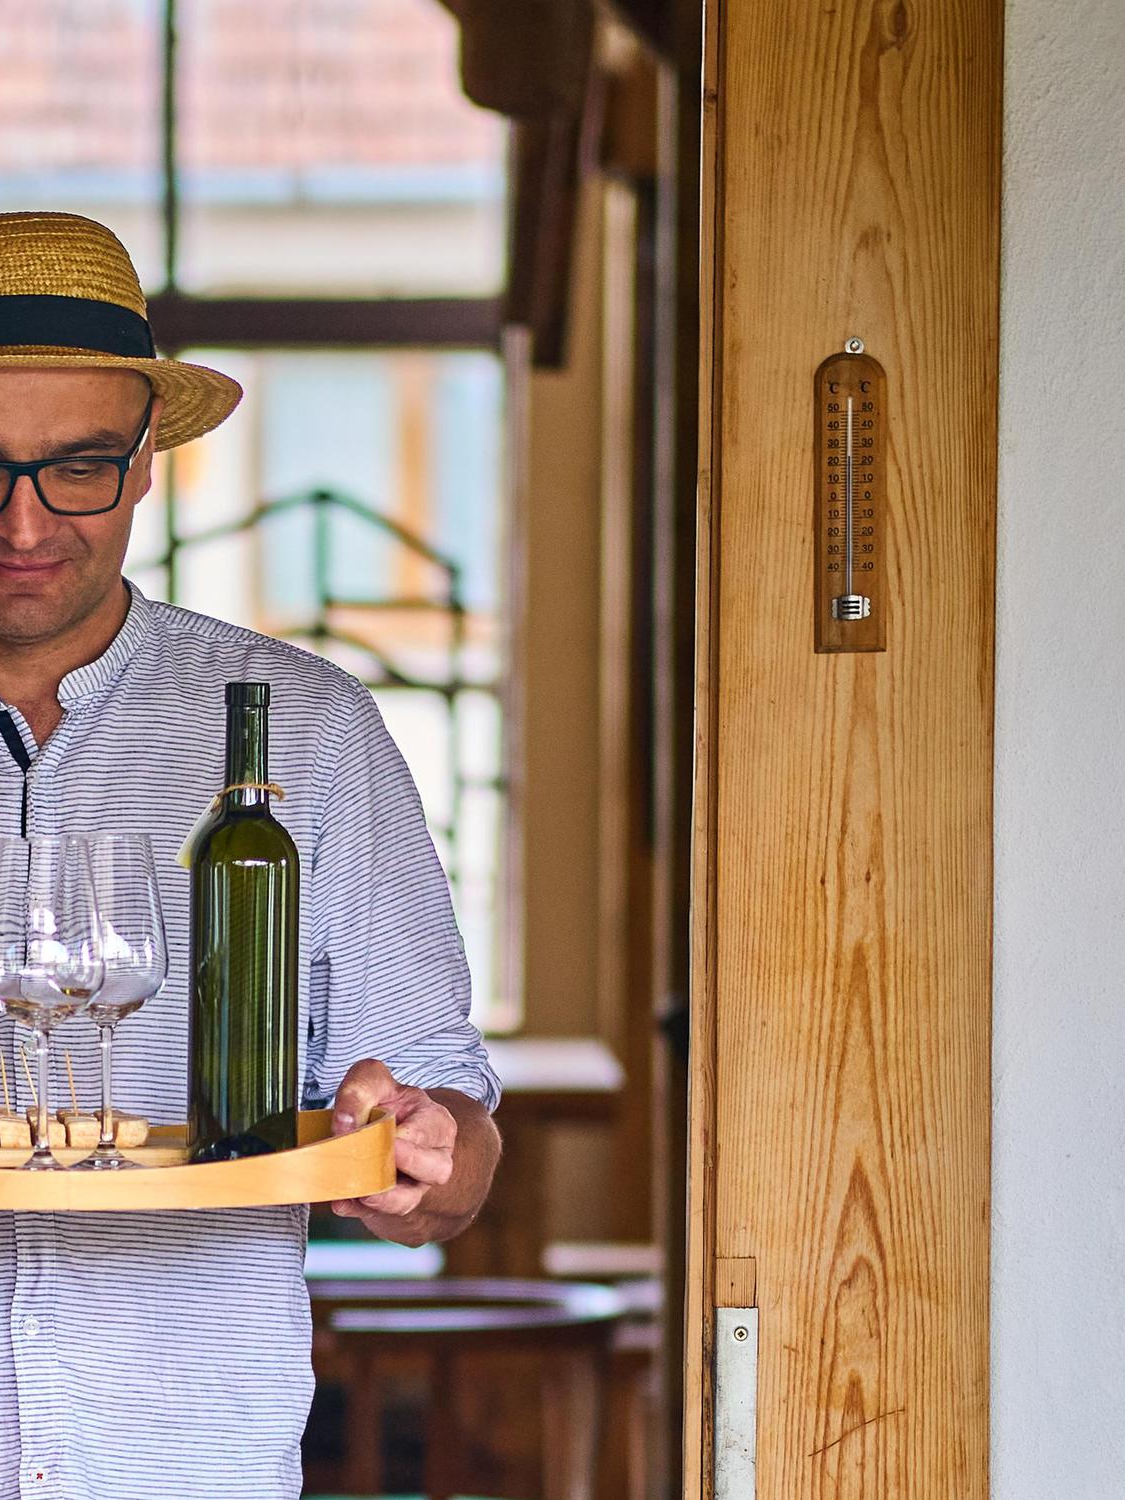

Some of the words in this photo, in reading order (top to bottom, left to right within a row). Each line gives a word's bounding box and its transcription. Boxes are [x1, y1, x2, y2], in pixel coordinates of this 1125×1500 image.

[828, 403, 839, 411] 50
[862, 402, 873, 410] 50
[828, 421, 839, 429] 40
[862, 420, 873, 428] 40
[828, 439, 839, 447] 30
[862, 438, 873, 446] 30
[828, 456, 839, 464] 20
[862, 456, 873, 464] 20
[828, 474, 839, 482] 10
[862, 473, 873, 481] 10
[830, 492, 836, 500] 0
[865, 491, 871, 499] 0
[862, 509, 873, 517] 10
[828, 528, 839, 536] 20
[862, 527, 873, 535] 20
[828, 545, 839, 553] 30
[862, 544, 873, 552] 30
[828, 563, 839, 571] 40
[862, 562, 873, 570] 40
